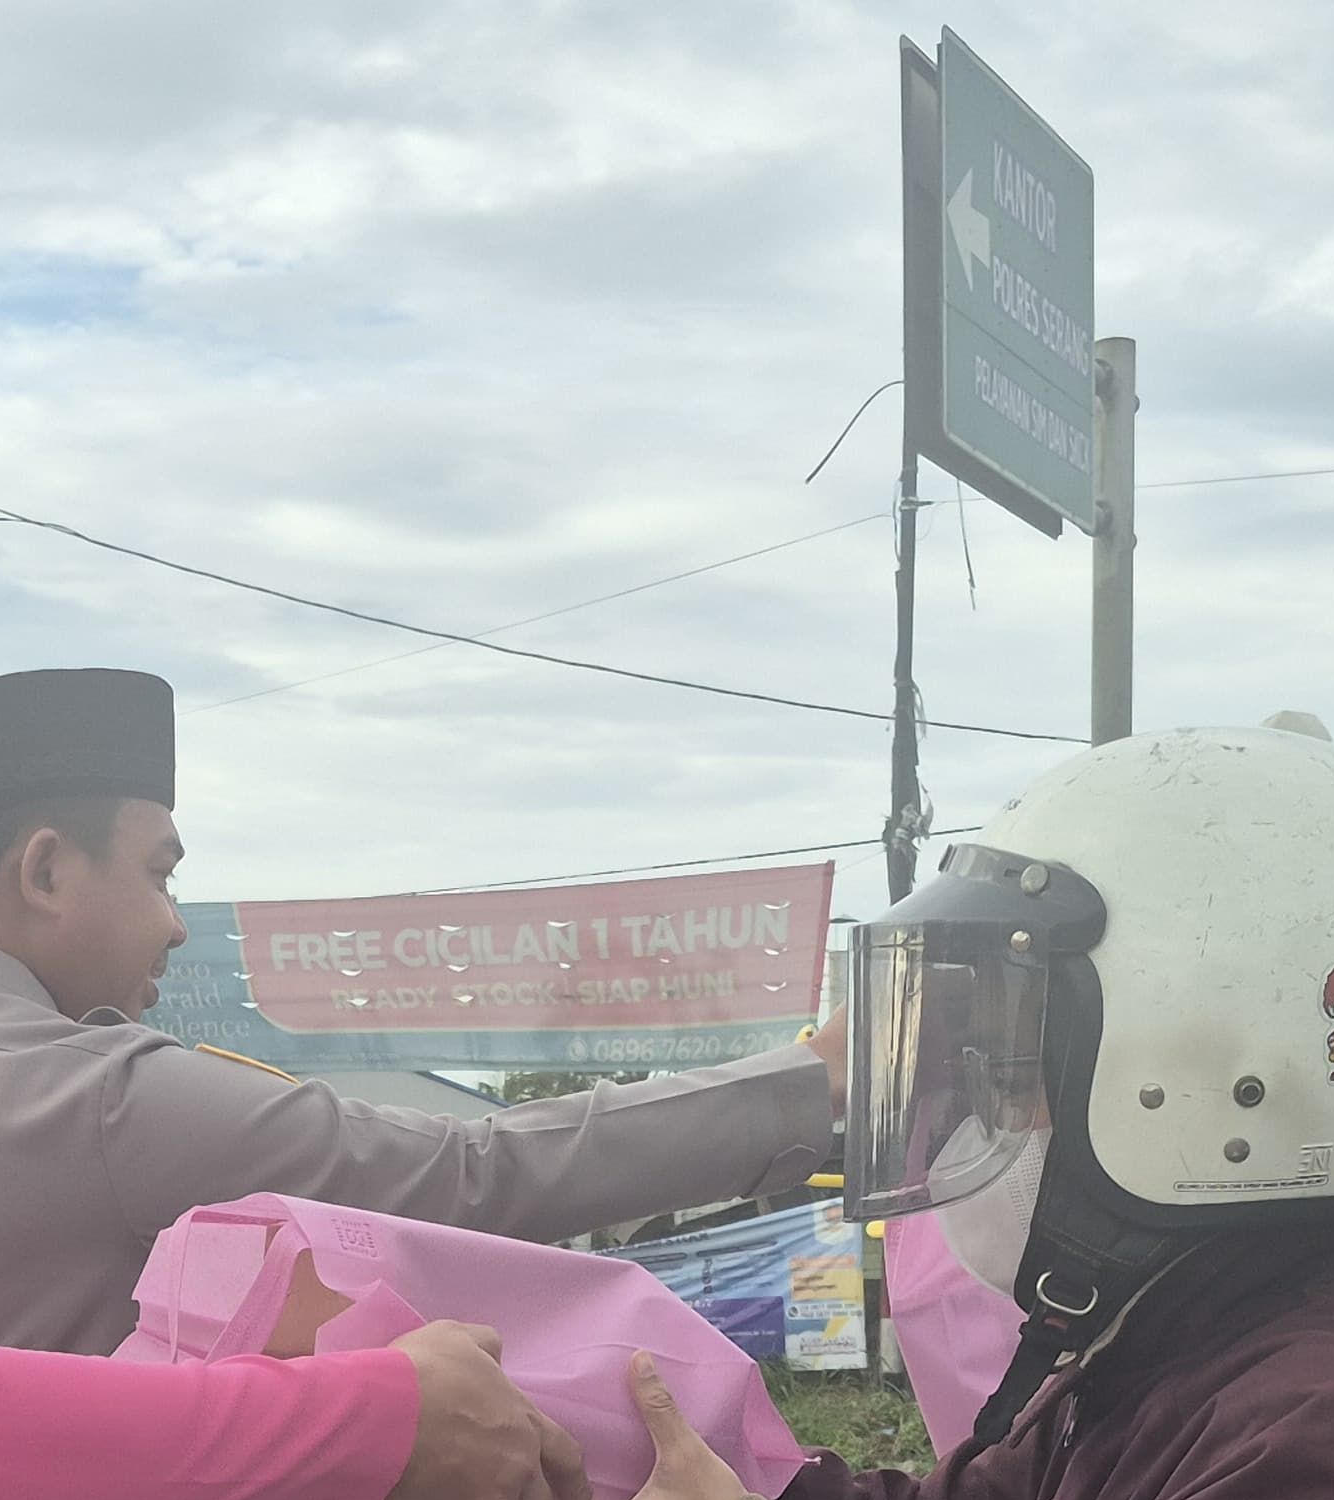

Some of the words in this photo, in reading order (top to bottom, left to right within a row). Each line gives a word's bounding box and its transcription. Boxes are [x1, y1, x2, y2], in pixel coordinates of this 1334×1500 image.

[992, 140, 1057, 254] KANTOR
[992, 254, 1040, 338] POLRES
[1041, 295, 1089, 377] SERANG
[974, 354, 1030, 432] PELAYANAN
[268, 929, 389, 972] FREE
[394, 919, 582, 967] CICILAN
[590, 917, 611, 960] 1
[621, 902, 791, 958] TAHUN
[330, 985, 436, 1010] READY
[450, 979, 559, 1007] STOCK
[576, 977, 651, 1006] SIAP
[594, 1036, 655, 1064] 0896
[662, 1036, 721, 1060] 7620
